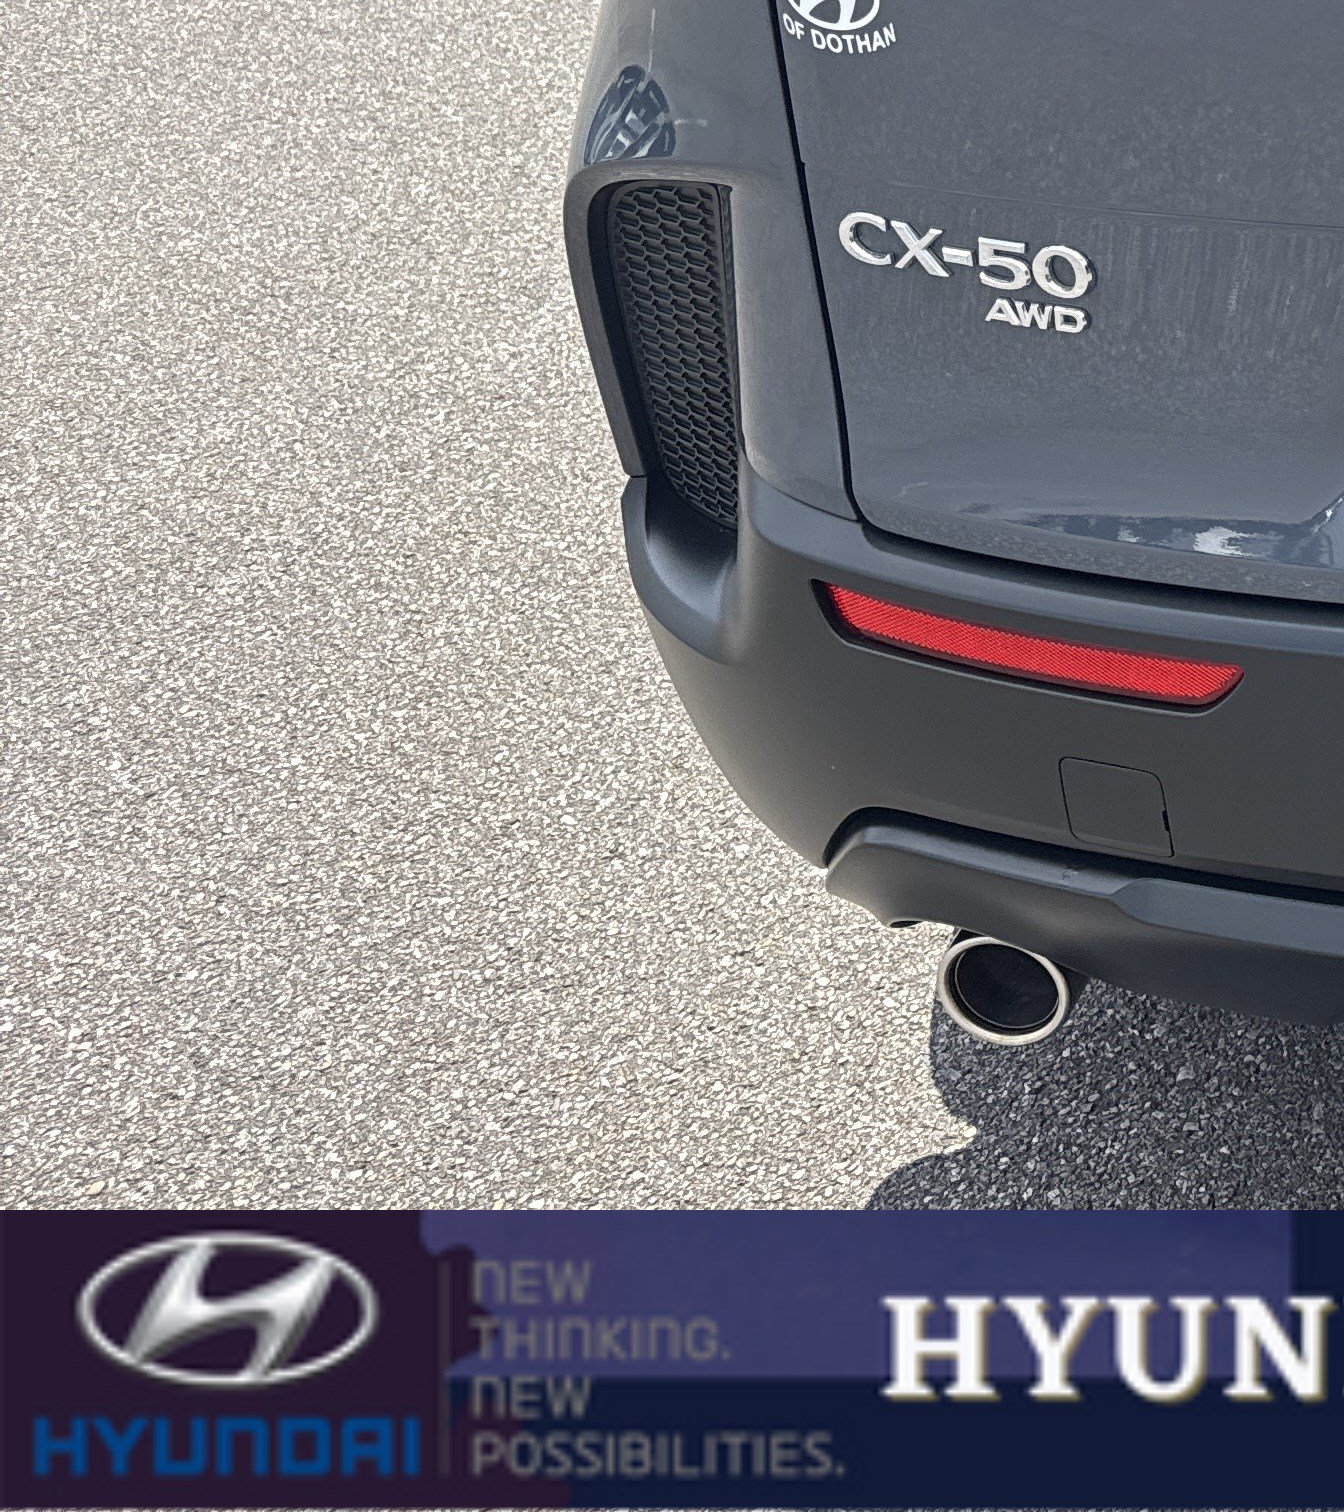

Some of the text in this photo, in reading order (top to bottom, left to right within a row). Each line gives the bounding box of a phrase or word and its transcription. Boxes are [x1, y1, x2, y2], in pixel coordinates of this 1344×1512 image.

[782, 13, 897, 54] OF DOTHAN
[838, 211, 1095, 300] CX-50
[984, 297, 1089, 334] AWD
